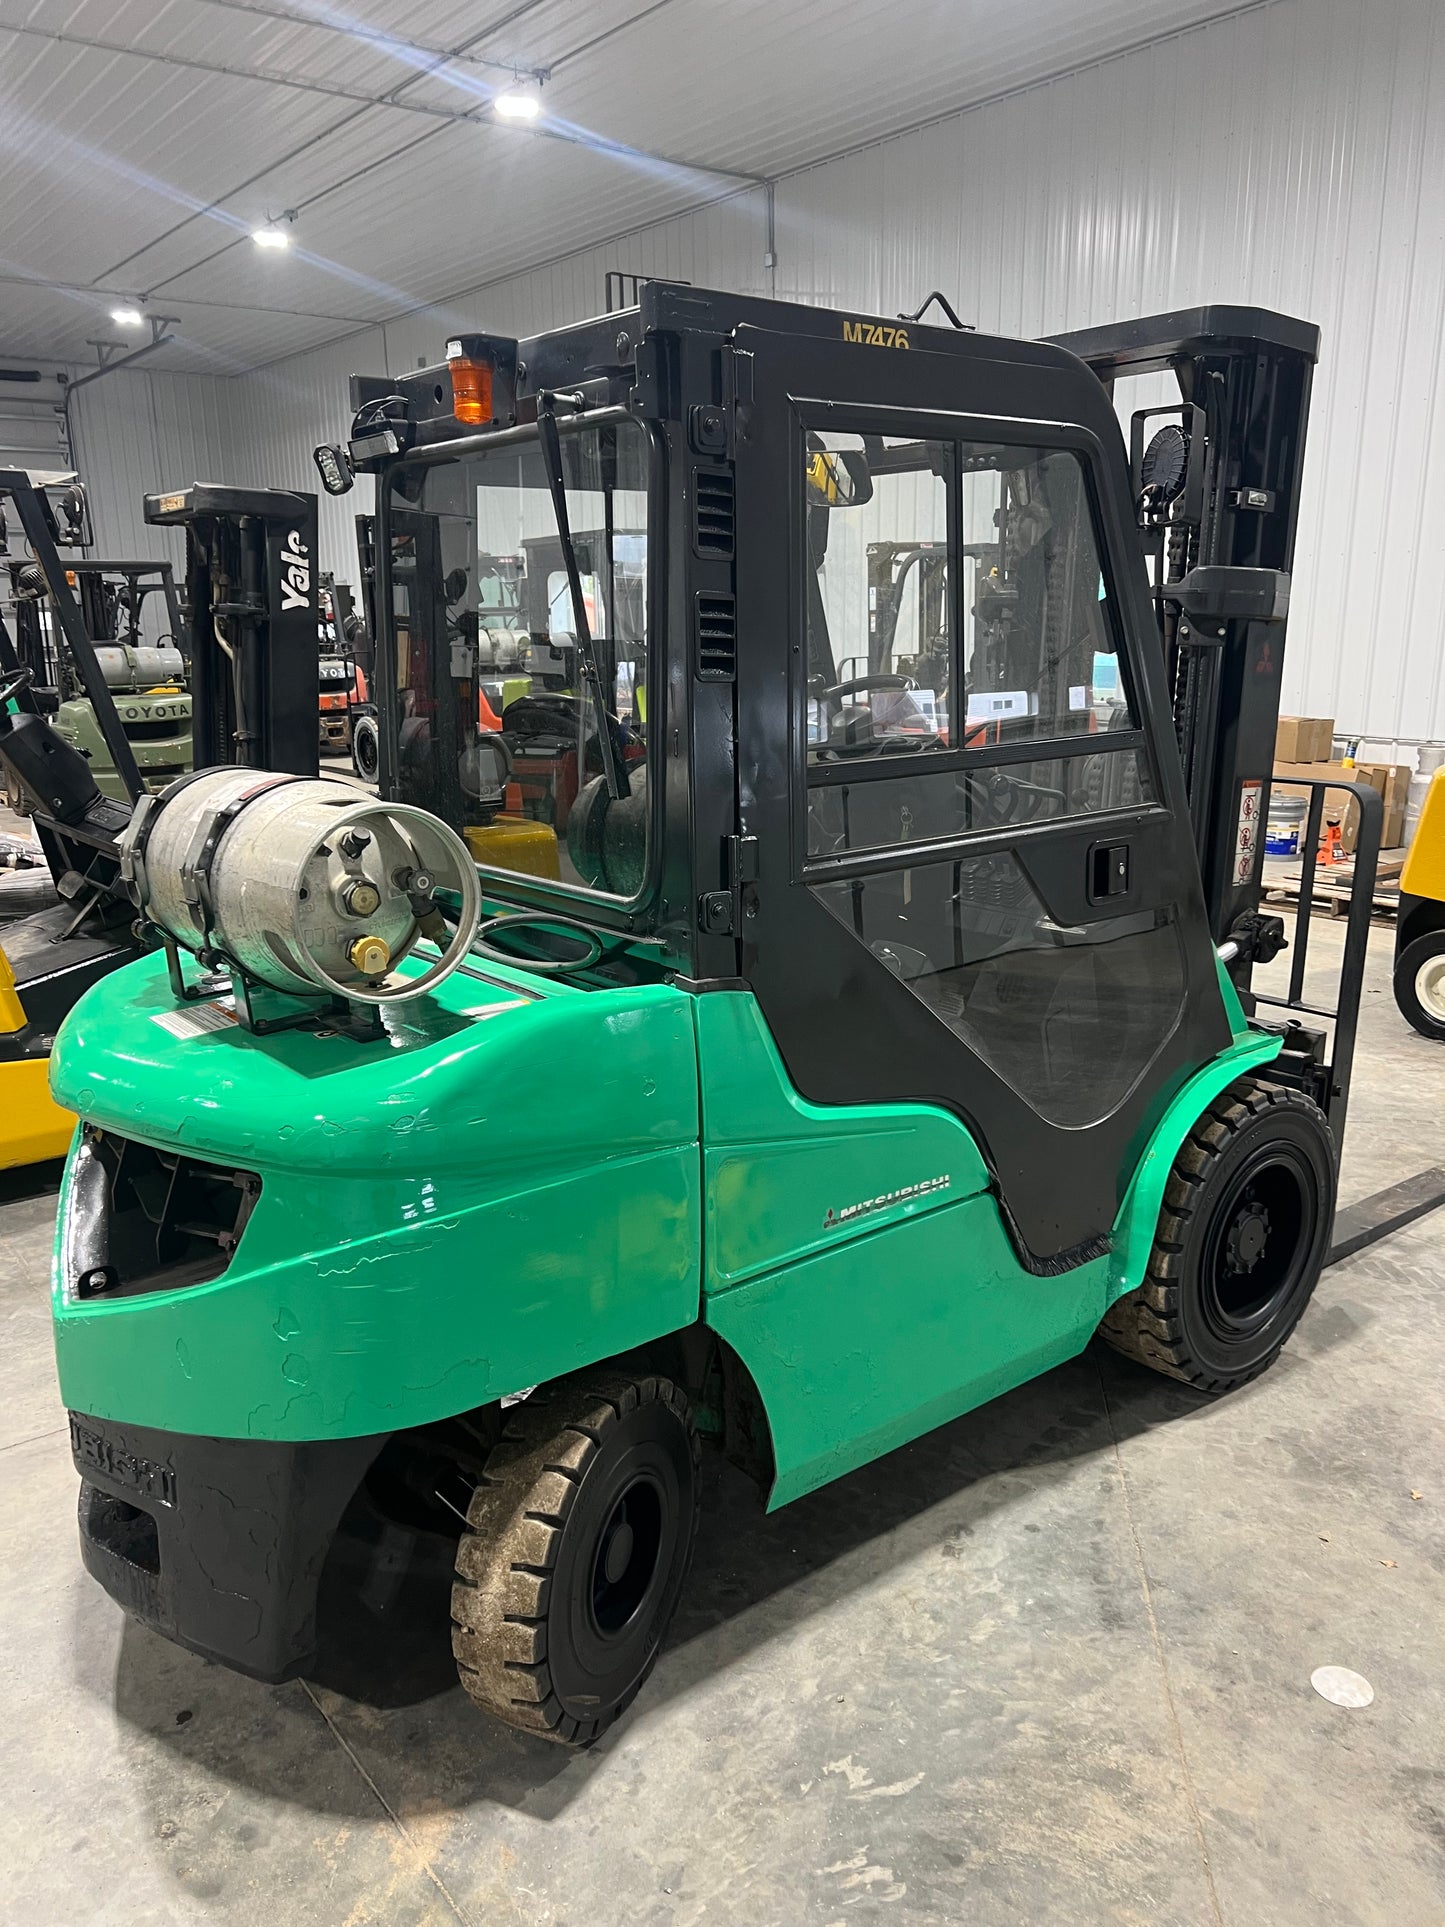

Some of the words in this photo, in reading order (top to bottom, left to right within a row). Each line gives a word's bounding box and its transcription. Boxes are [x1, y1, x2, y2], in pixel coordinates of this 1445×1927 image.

[843, 320, 910, 350] M7476
[281, 529, 310, 611] Yale
[117, 704, 190, 720] OYOTA
[840, 1174, 950, 1223] MITSUBISHI
